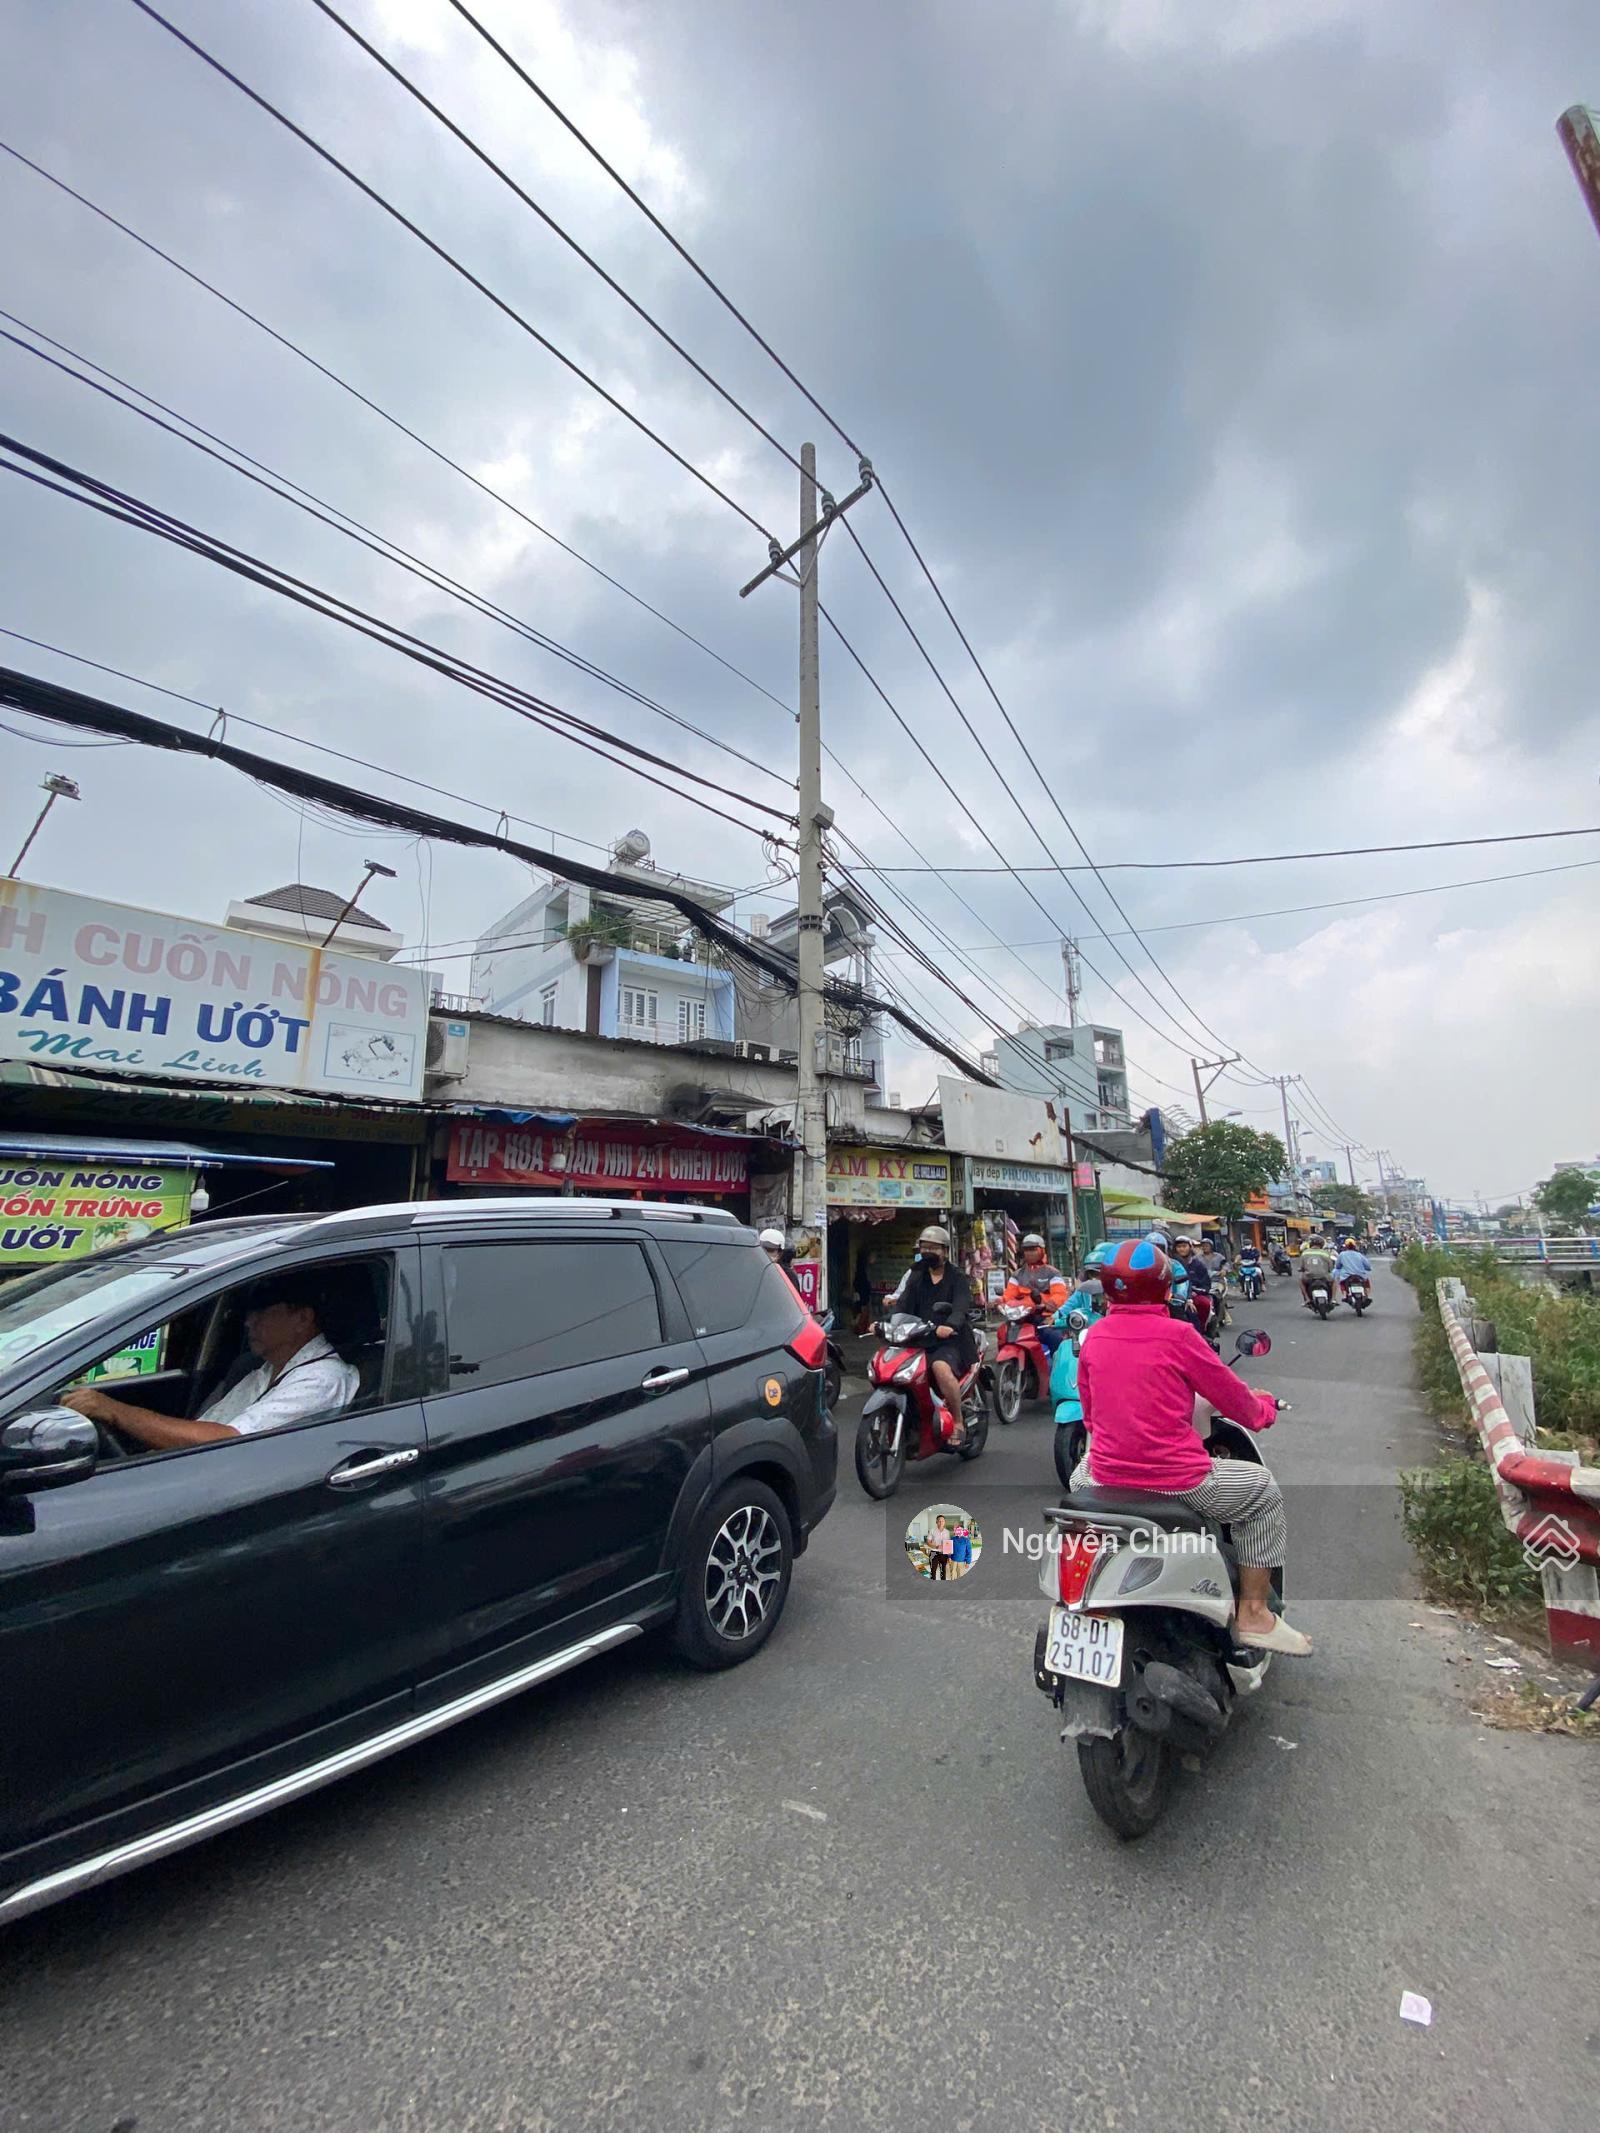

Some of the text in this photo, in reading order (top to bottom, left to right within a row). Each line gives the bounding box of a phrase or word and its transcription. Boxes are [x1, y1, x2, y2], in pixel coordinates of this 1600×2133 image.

[74, 924, 252, 991] CUỐN
[272, 962, 408, 1018] NÓNG
[197, 1001, 310, 1054] ƯỚT
[18, 1029, 266, 1078] Mai Linh
[458, 1127, 499, 1177] TẠP
[603, 1142, 633, 1177] NHI
[636, 1145, 664, 1179] 241
[70, 1170, 163, 1190] NÓNG
[0, 1189, 163, 1218] ỐN TRỨNG
[1, 1223, 84, 1250] ƯỚT
[1050, 1641, 1115, 1679] 251.07
